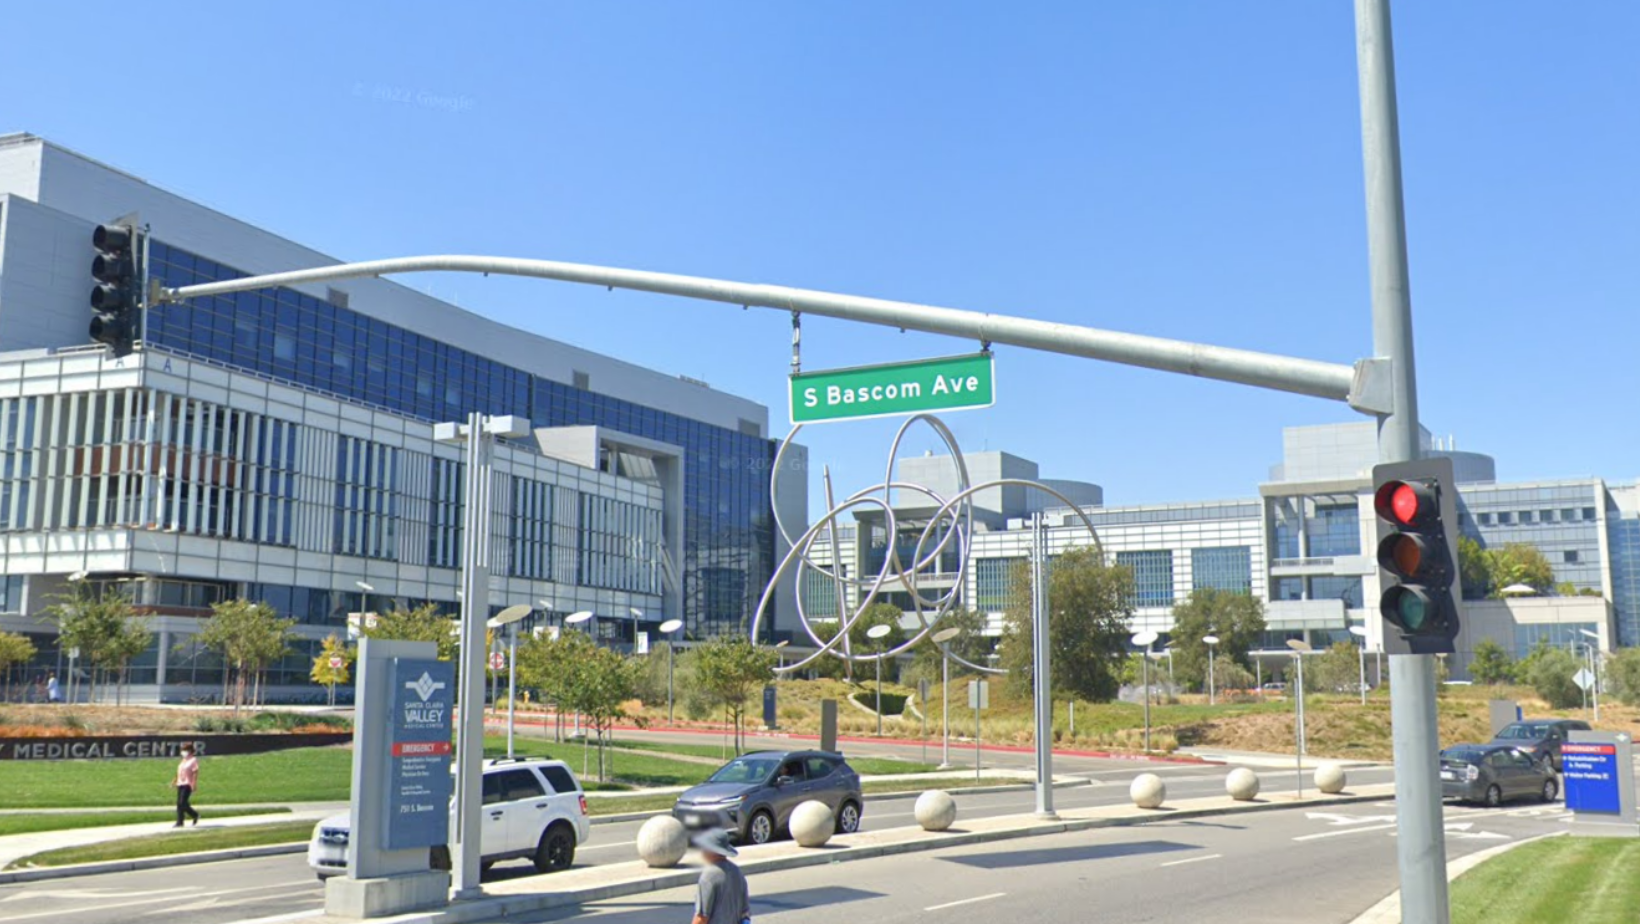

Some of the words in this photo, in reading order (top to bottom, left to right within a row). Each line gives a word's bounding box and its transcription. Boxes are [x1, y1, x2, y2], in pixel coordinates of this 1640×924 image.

[804, 388, 818, 407] S
[827, 381, 921, 405] Bascom
[932, 374, 979, 395] Ave
[404, 709, 444, 723] VALLEY
[13, 742, 115, 759] MEDICAL
[402, 743, 435, 753] EMERGENCY
